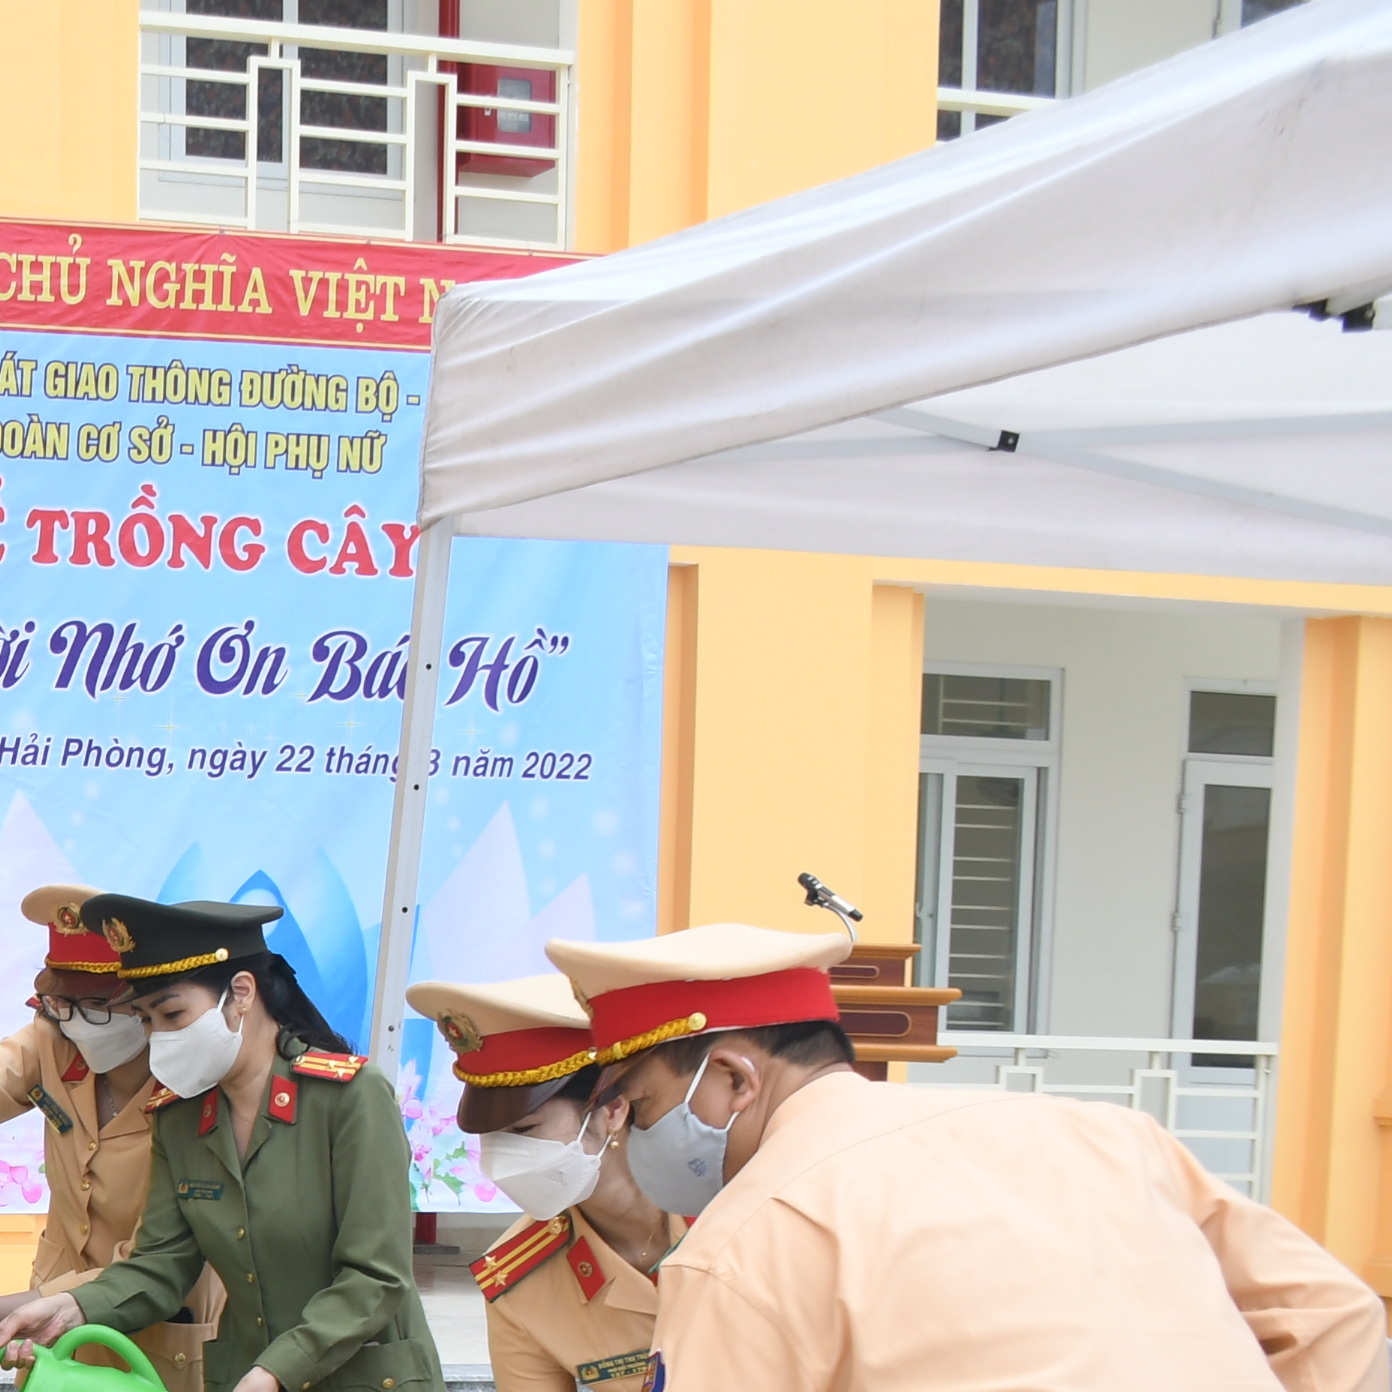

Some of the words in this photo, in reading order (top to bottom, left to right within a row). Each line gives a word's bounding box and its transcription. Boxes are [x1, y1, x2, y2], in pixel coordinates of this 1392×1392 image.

[106, 253, 273, 314] NGHĨA
[289, 257, 406, 333] VIỆT
[44, 360, 119, 402] GIAO
[126, 359, 232, 407] THÔNG
[239, 363, 348, 413] ĐƯỜNG
[356, 370, 399, 422] BỘ
[77, 420, 122, 463] CƠ
[128, 415, 174, 464] SỞ
[201, 422, 257, 475] HỘI
[265, 432, 330, 479] PHỤ
[336, 430, 388, 474] NỮ
[26, 484, 266, 571] TRỒNG
[287, 504, 421, 577] CÂY
[49, 620, 185, 699] Nhớ
[196, 620, 289, 696] Ơn
[61, 737, 175, 777] Phòng,
[188, 741, 267, 779] ngày
[276, 744, 315, 773] 22
[452, 748, 514, 778] năm
[521, 751, 592, 780] 2022
